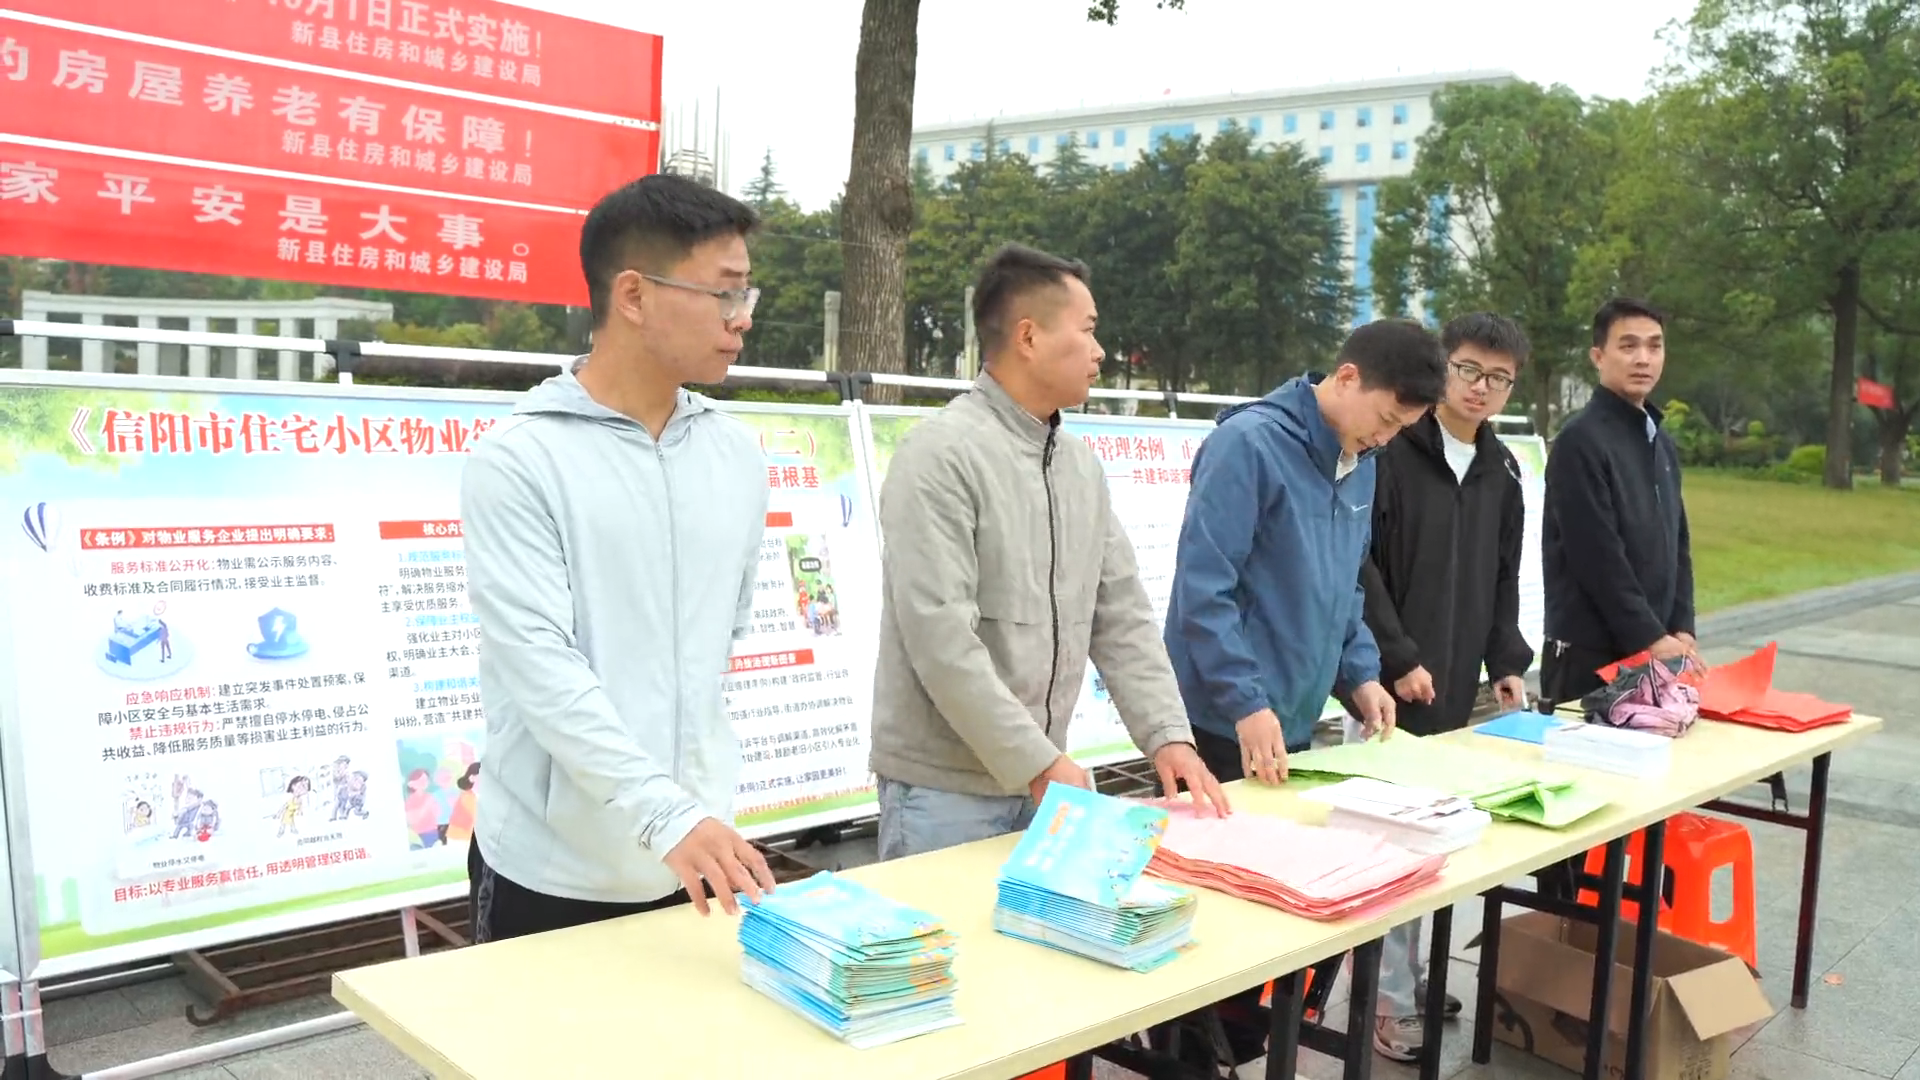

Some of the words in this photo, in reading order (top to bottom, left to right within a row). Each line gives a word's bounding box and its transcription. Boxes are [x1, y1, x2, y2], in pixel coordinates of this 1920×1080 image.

[269, 0, 542, 58] 月1日正式实施！
[290, 20, 541, 87] 新县住房和城乡建设局
[281, 129, 533, 187] 新县住房和城乡建设局
[277, 237, 528, 284] 新县住房和城乡建设局
[399, 565, 468, 580] 明确物业服务
